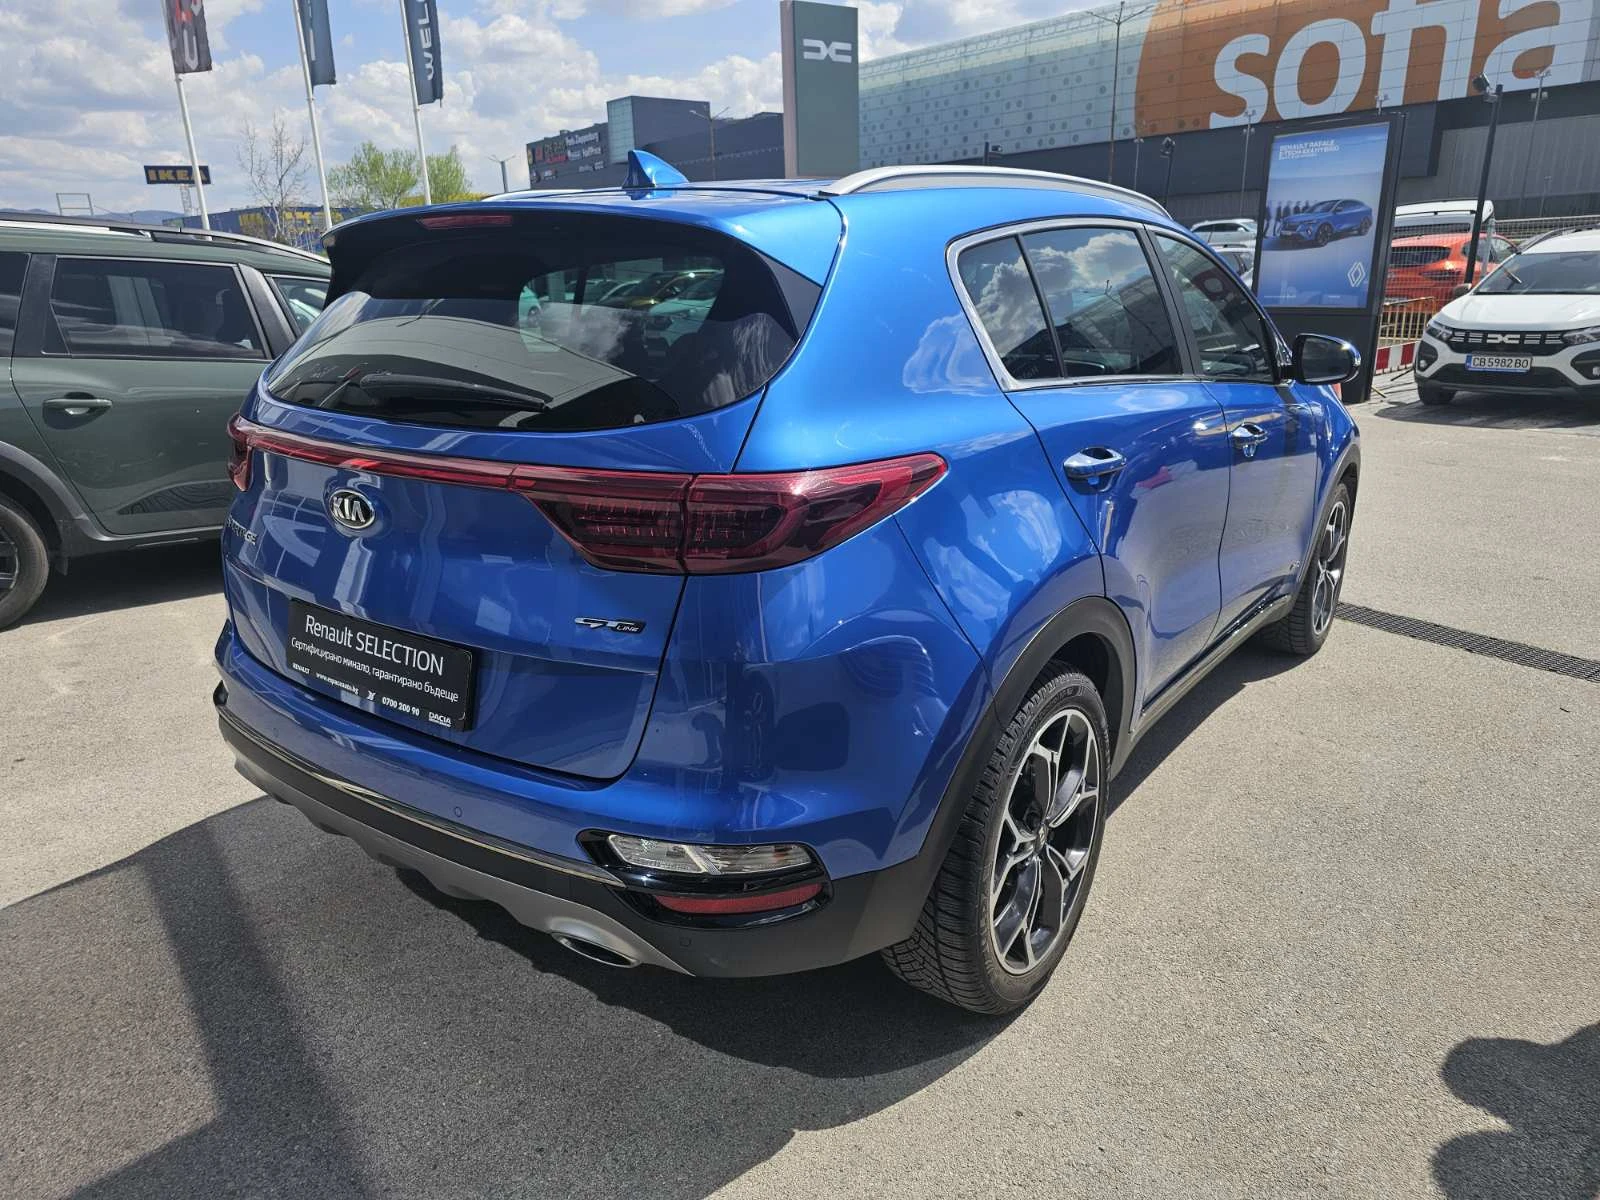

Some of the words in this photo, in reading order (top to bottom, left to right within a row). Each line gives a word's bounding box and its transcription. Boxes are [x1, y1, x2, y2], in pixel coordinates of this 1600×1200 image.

[417, 0, 434, 80] WEL
[333, 496, 366, 523] KIA
[305, 614, 354, 649] Renault
[355, 631, 444, 676] SELECTION
[291, 636, 343, 664] Сертифицирано
[343, 657, 372, 676] минало,
[372, 667, 423, 690] гарантирано
[424, 681, 459, 703] бъдеще
[382, 696, 398, 709] 0700
[398, 702, 411, 713] 200
[411, 706, 420, 717] 90
[428, 711, 452, 724] DACIA
